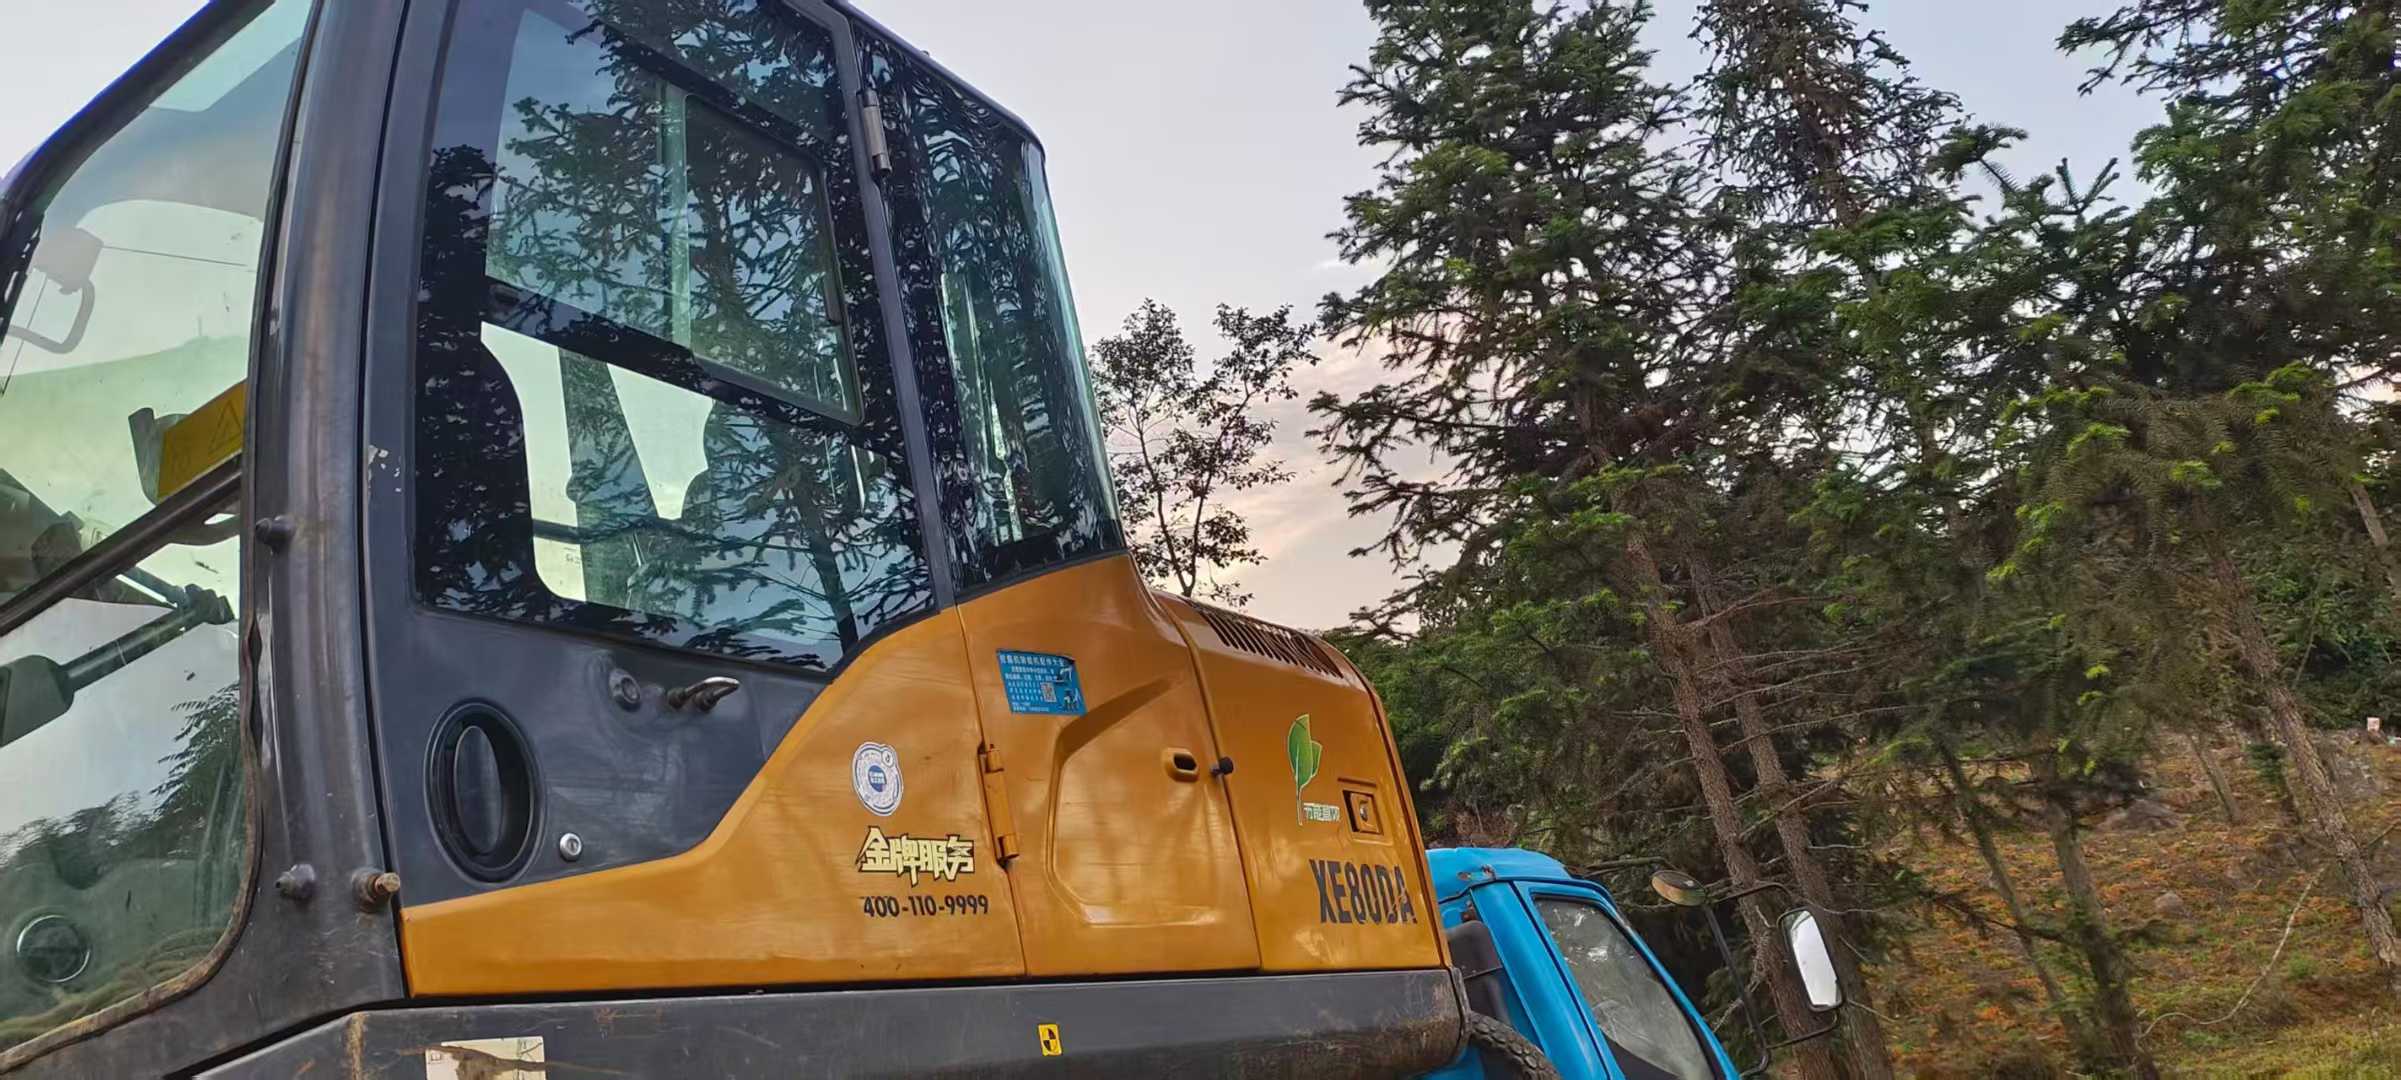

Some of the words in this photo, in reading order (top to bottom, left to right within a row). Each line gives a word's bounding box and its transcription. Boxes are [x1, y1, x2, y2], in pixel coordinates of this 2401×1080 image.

[856, 826, 975, 887] 金牌服务
[863, 895, 989, 917] 400-110-9999
[1309, 859, 1418, 924] XE80DA
